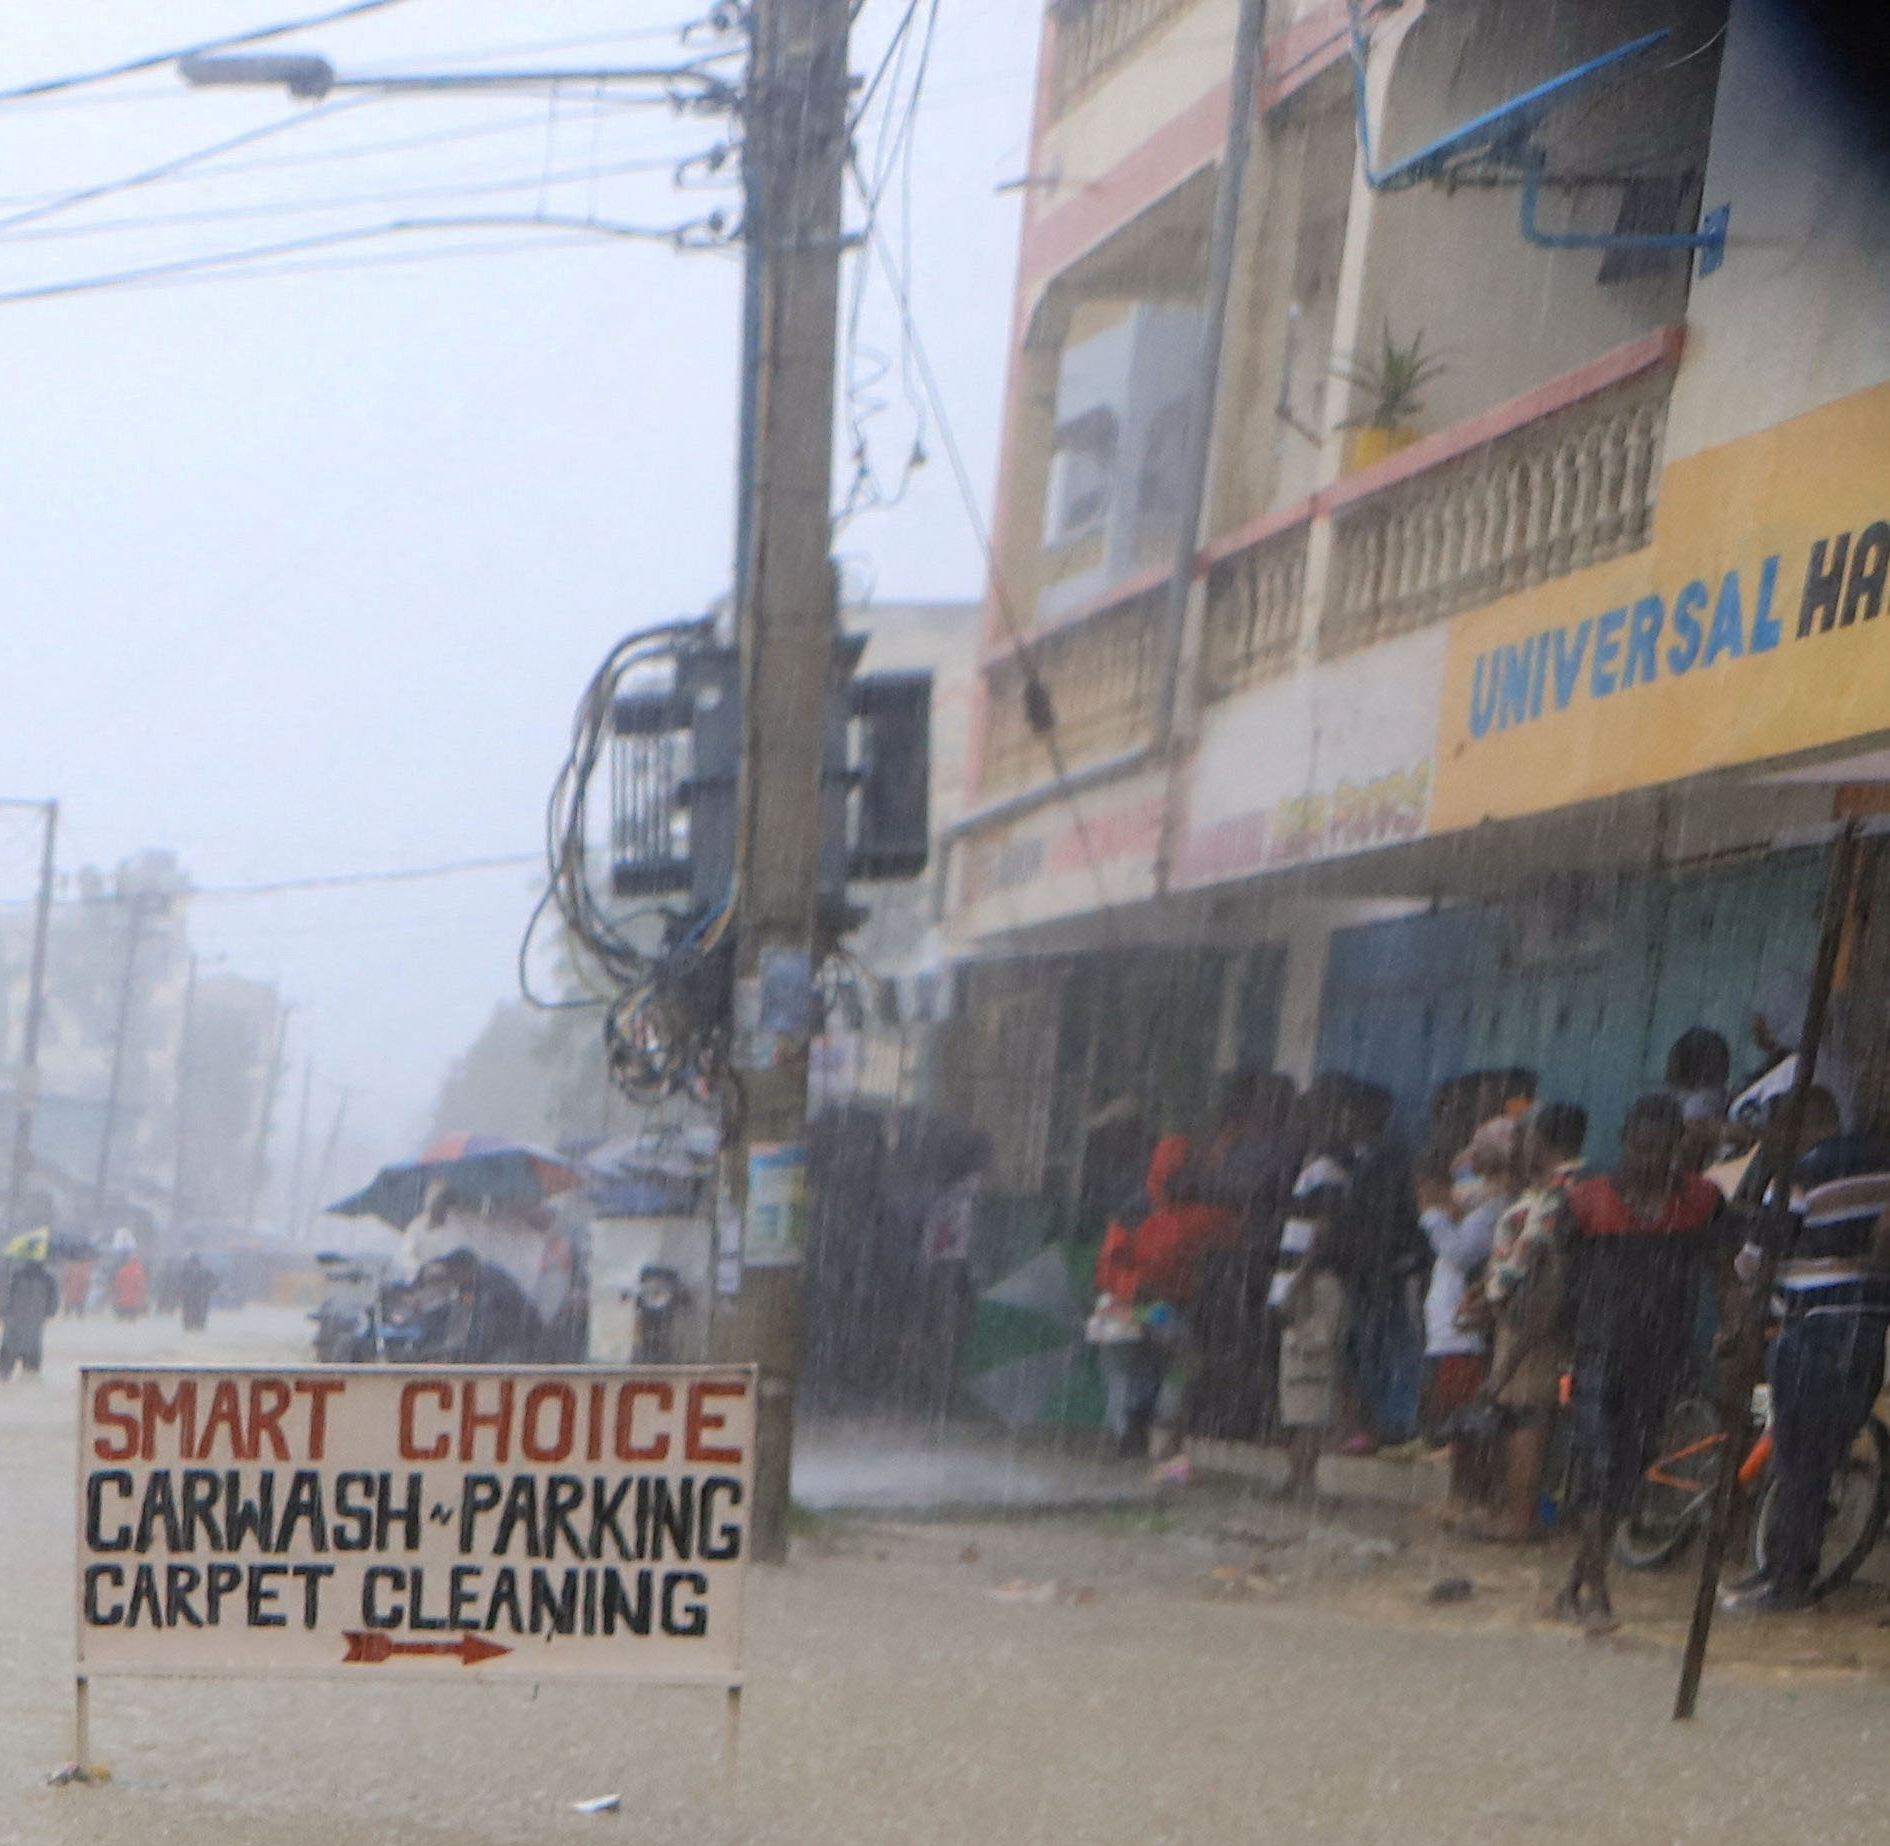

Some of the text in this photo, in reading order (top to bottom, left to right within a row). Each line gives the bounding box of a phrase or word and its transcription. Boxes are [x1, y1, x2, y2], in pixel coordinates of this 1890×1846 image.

[1469, 553, 1783, 740] UNIVERSAL
[93, 1379, 748, 1465] SMART CHOICE
[85, 1564, 708, 1637] CARPET CLEANING
